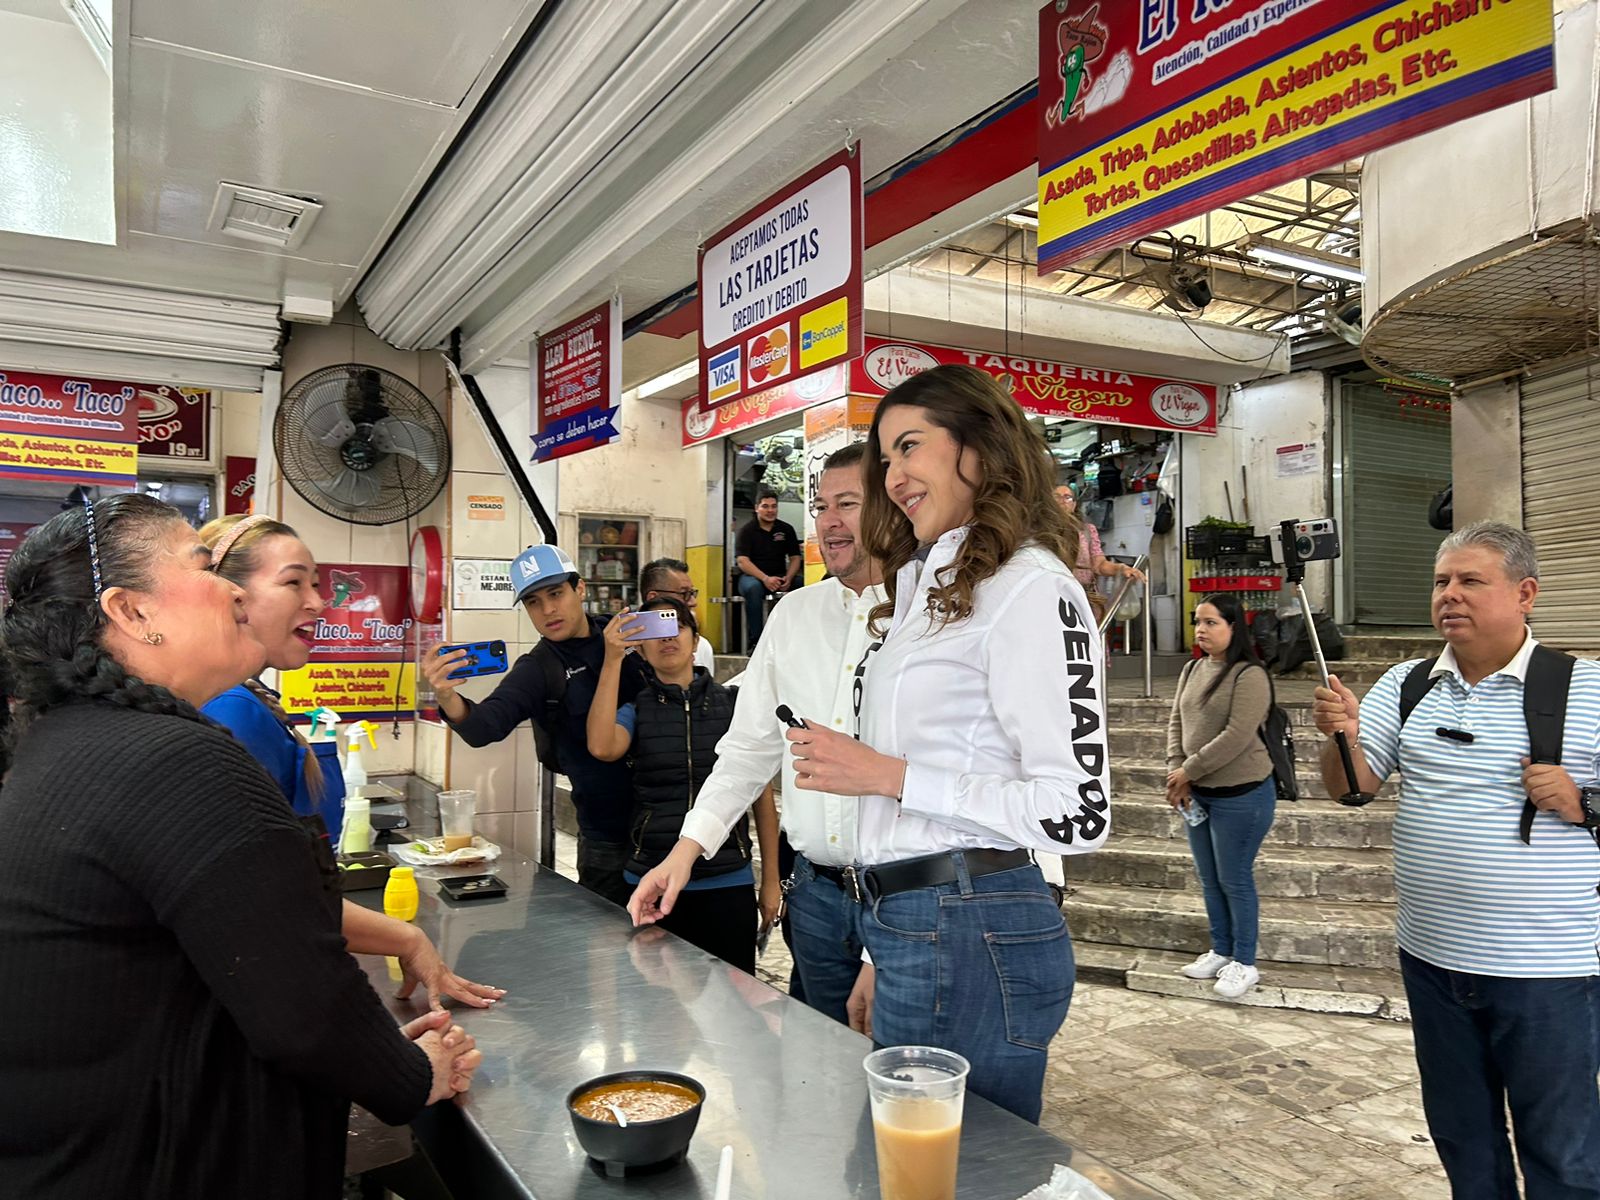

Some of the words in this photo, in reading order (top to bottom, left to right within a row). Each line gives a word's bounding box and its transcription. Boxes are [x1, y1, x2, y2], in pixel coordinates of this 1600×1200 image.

[1155, 45, 1204, 81] Atención,
[1207, 20, 1250, 52] Calidad
[1252, 14, 1261, 31] y
[1043, 165, 1097, 205] Asada,
[1099, 143, 1148, 176] Tripa,
[1151, 94, 1250, 154] Adobada,
[1254, 43, 1368, 109] Asientos,
[1372, 0, 1511, 53] Chicharr
[1083, 179, 1140, 217] Tortas,
[1143, 127, 1256, 192] Quesadillas
[1261, 72, 1396, 144] Ahogadas,
[1401, 47, 1458, 88] Etc.
[729, 217, 777, 265] ACEPTAMOS
[778, 198, 809, 232] TODAS
[719, 271, 742, 309] LAS
[745, 227, 820, 293] TARJETAS
[732, 303, 764, 333] CREDITO
[766, 294, 774, 316] Y
[775, 277, 807, 312] DEBITO
[749, 342, 789, 368] MasterCard
[962, 351, 1134, 387] TAQUERIA
[712, 362, 736, 388] VISA
[565, 420, 586, 439] deben
[587, 414, 609, 431] hacer
[1049, 409, 1075, 418] BUCHE
[1085, 413, 1121, 423] CARNITAS
[21, 439, 73, 455] Asientos,
[75, 443, 134, 458] Chicharrón
[24, 453, 84, 469] Ahogadas,
[85, 458, 107, 470] Etc.
[168, 442, 187, 457] 19
[470, 502, 503, 510] CENSADO
[1038, 596, 1108, 845] SENADORA
